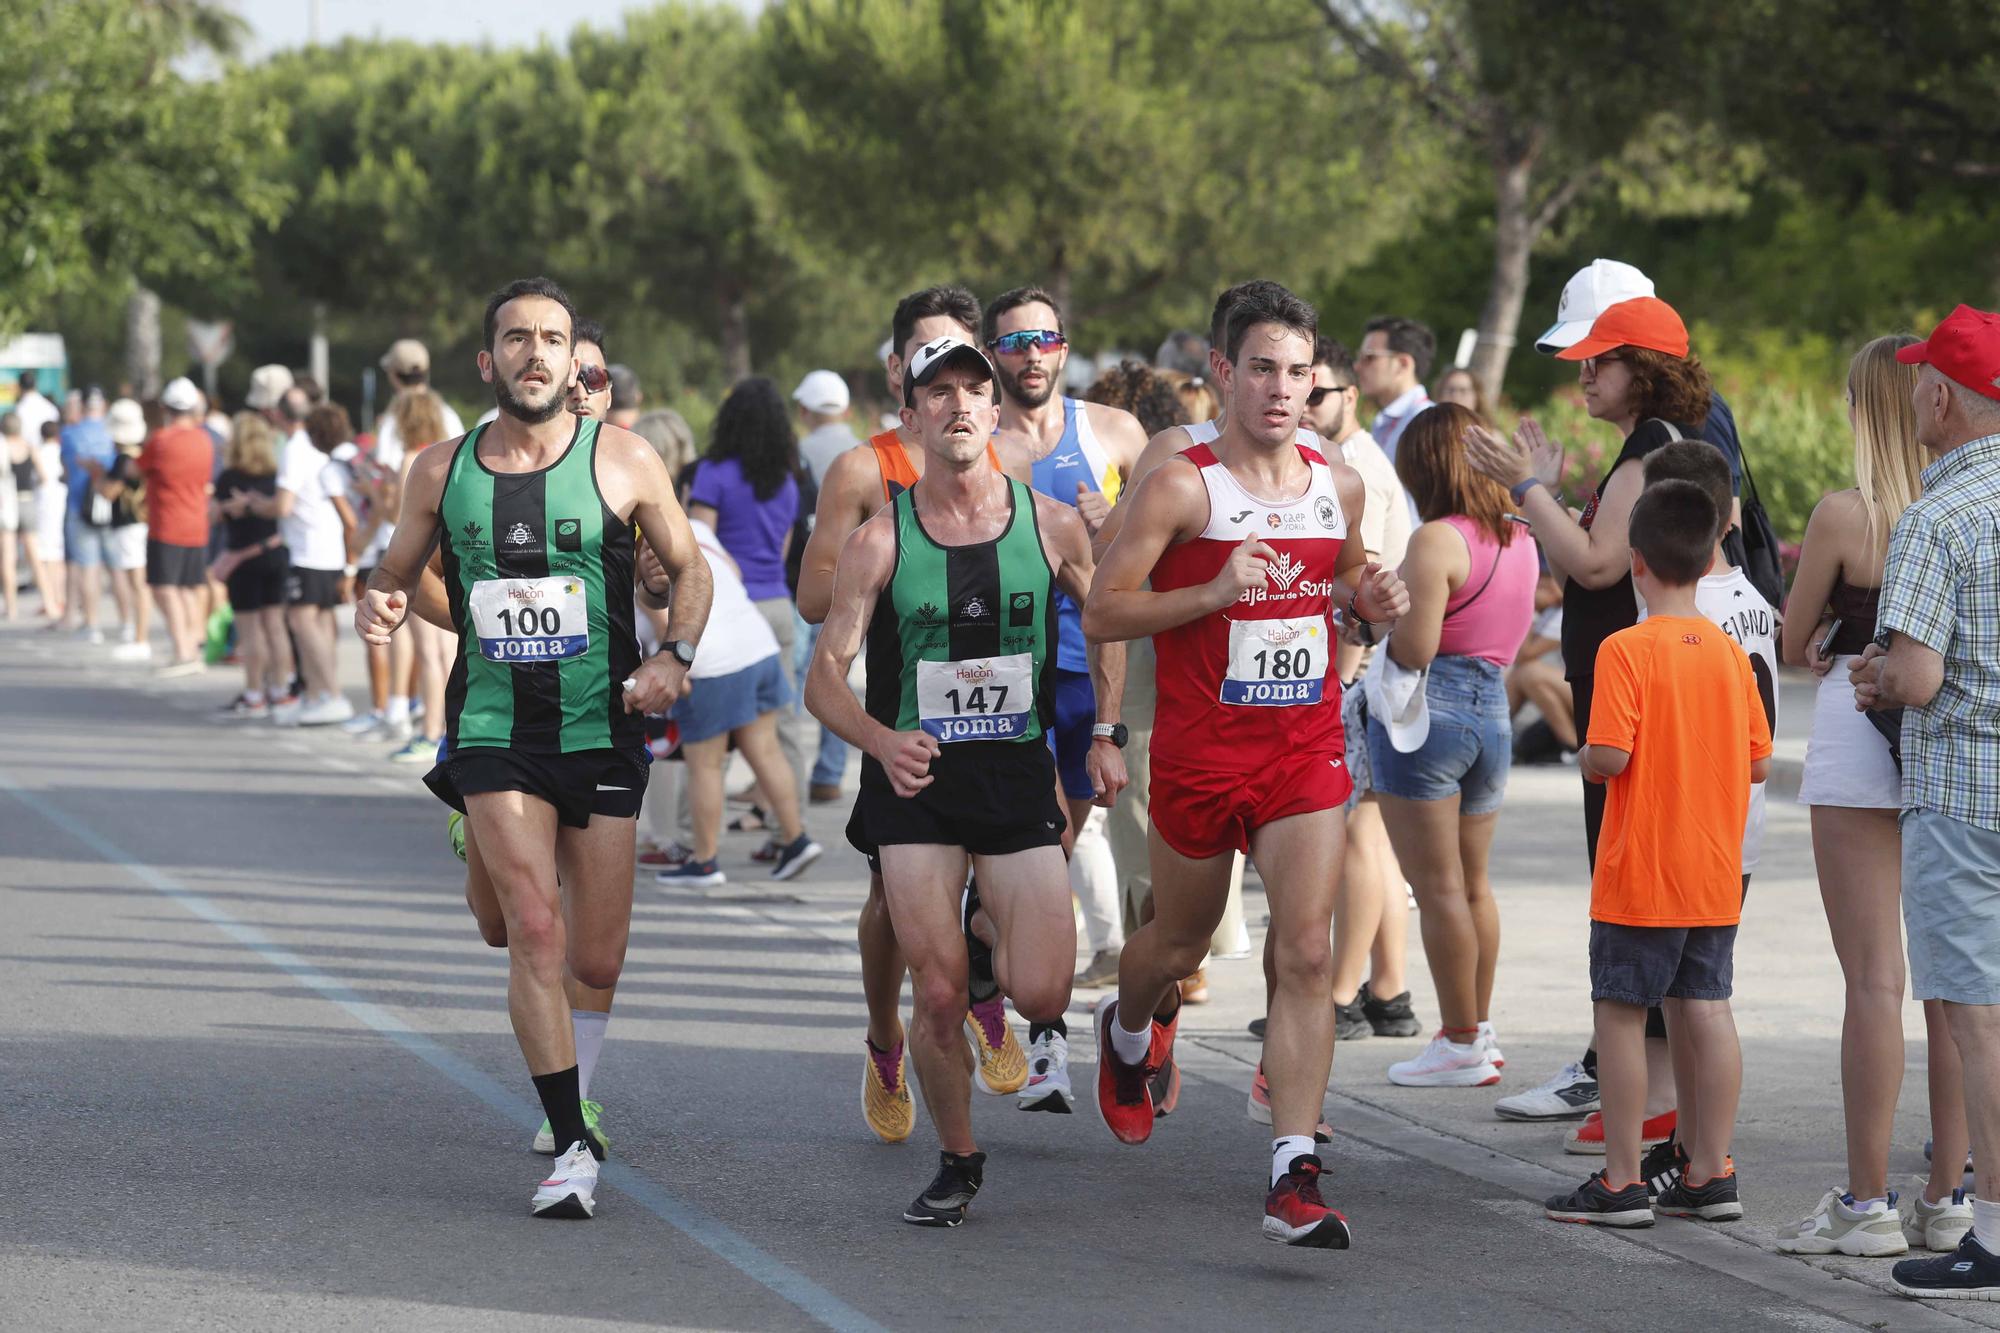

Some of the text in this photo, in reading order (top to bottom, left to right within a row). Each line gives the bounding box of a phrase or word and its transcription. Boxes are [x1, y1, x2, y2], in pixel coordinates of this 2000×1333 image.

[1239, 586, 1267, 607] aja
[1269, 592, 1285, 601] rural
[1286, 591, 1298, 599] de
[496, 606, 561, 636] 100
[1253, 648, 1311, 679] 180
[944, 685, 1009, 715] 147
